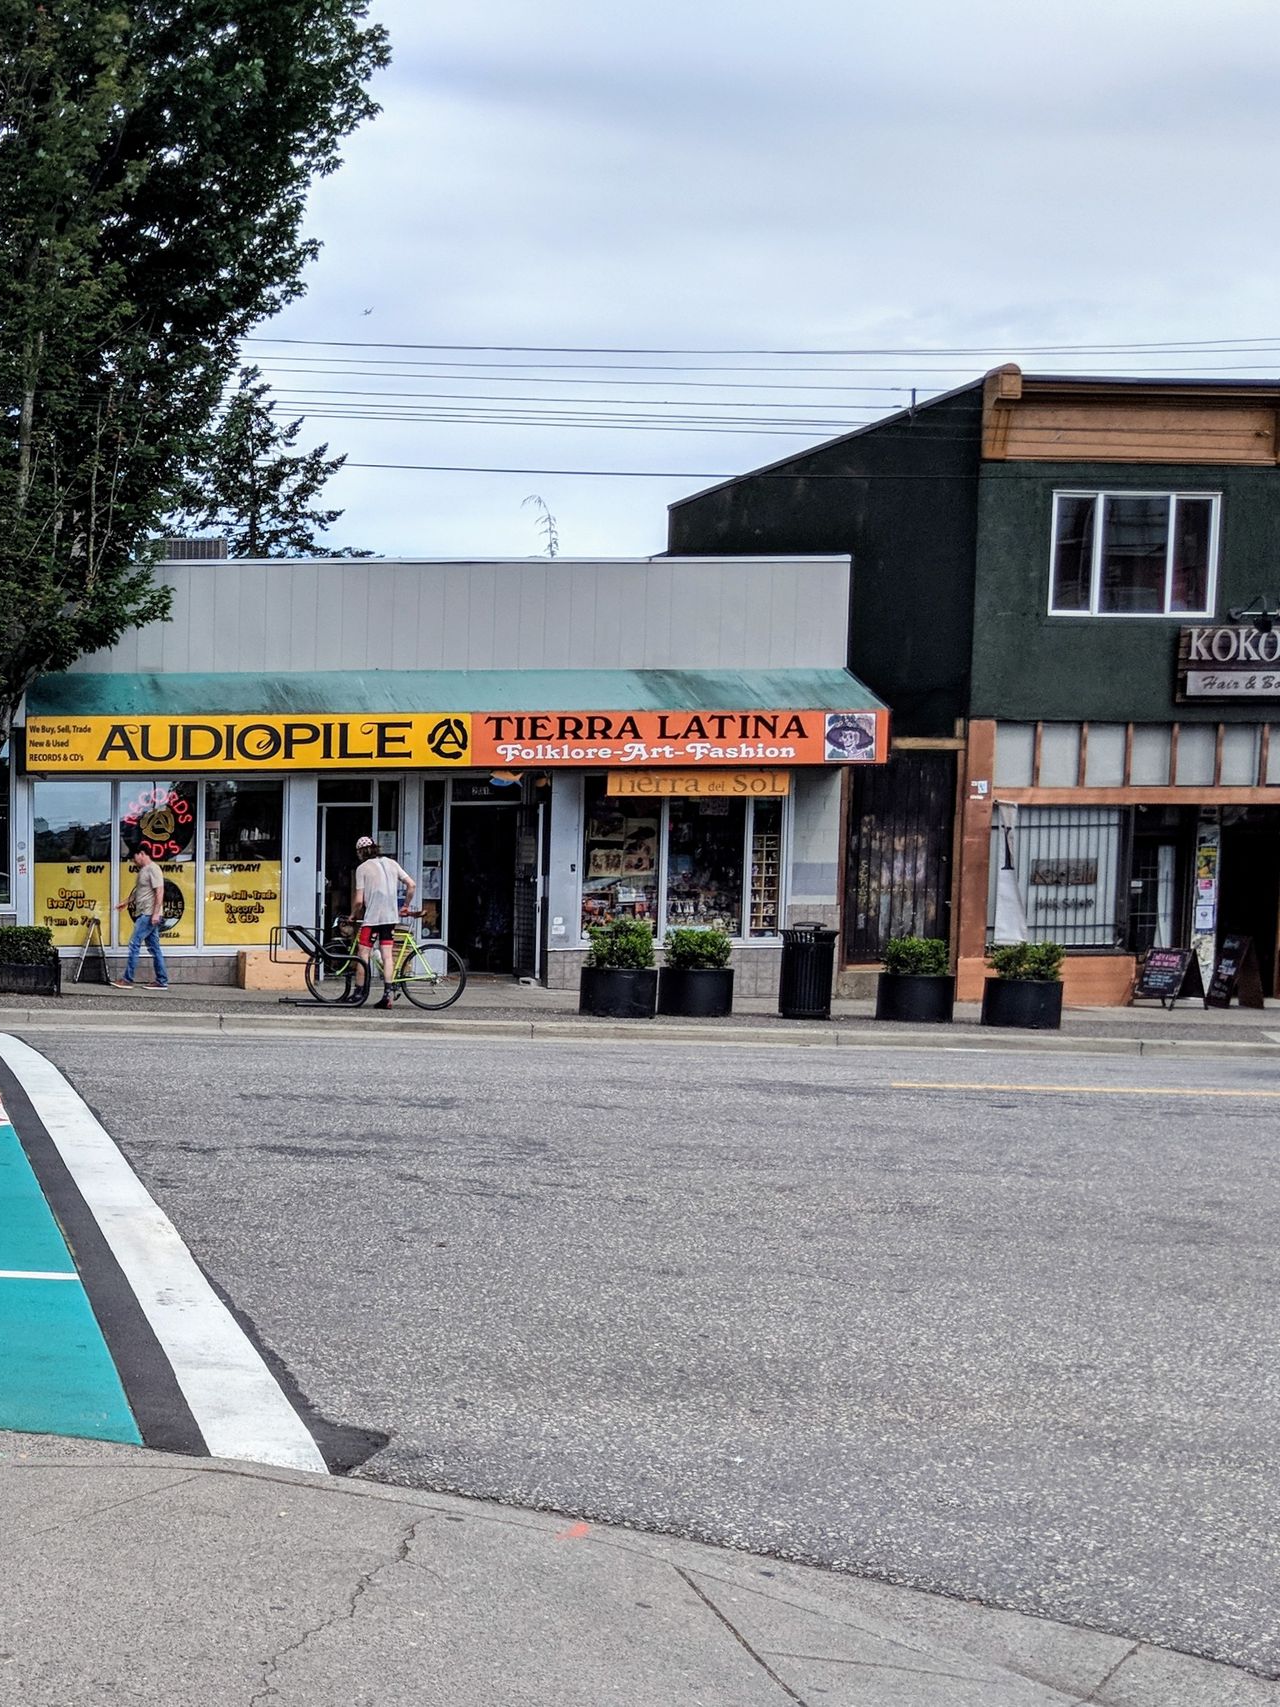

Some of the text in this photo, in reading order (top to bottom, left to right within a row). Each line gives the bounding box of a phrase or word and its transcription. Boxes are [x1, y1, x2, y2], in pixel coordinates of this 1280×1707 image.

[1201, 675, 1240, 690] Hair
[1244, 675, 1257, 690] &
[29, 725, 40, 733] We
[73, 724, 92, 733] Trade
[484, 714, 809, 741] TIERRA LATINA
[29, 739, 44, 748] New
[52, 739, 70, 748] Used
[96, 721, 414, 761] AUDIOPILE
[29, 753, 61, 762] RECORDS
[69, 753, 84, 762] CD's
[123, 787, 193, 825] RECORDS
[66, 865, 81, 874] WE
[86, 865, 105, 874] BUY
[58, 888, 86, 901] Open
[252, 889, 277, 900] Trade
[47, 898, 97, 912] Every Day
[224, 902, 265, 914] Records
[69, 916, 79, 926] to
[238, 913, 260, 924] CDs
